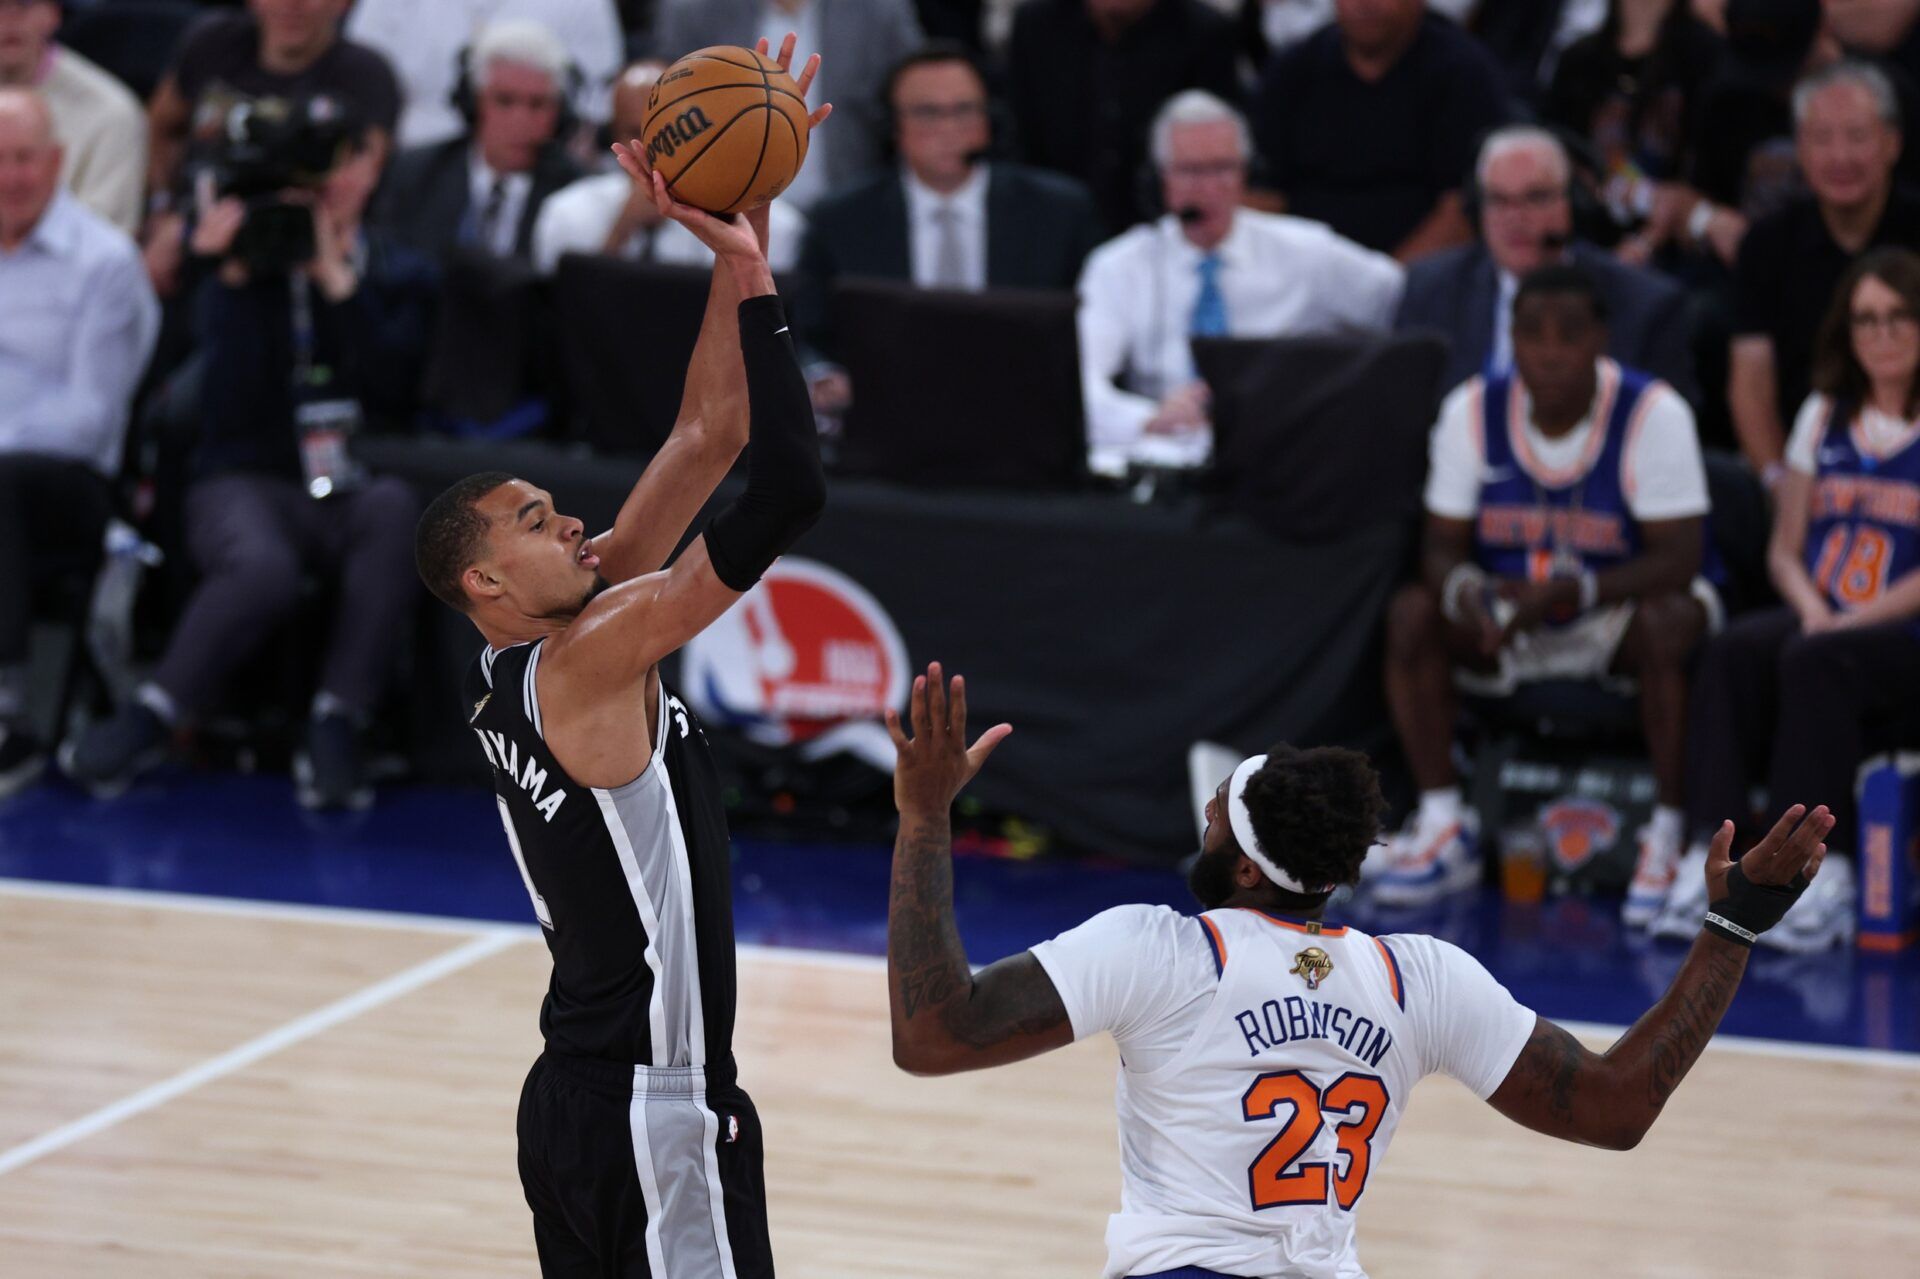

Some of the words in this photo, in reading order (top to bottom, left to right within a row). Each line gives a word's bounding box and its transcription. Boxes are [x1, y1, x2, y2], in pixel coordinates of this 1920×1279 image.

[646, 106, 713, 169] Wilso
[1814, 521, 1894, 606] 18
[1241, 1069, 1390, 1211] 23
